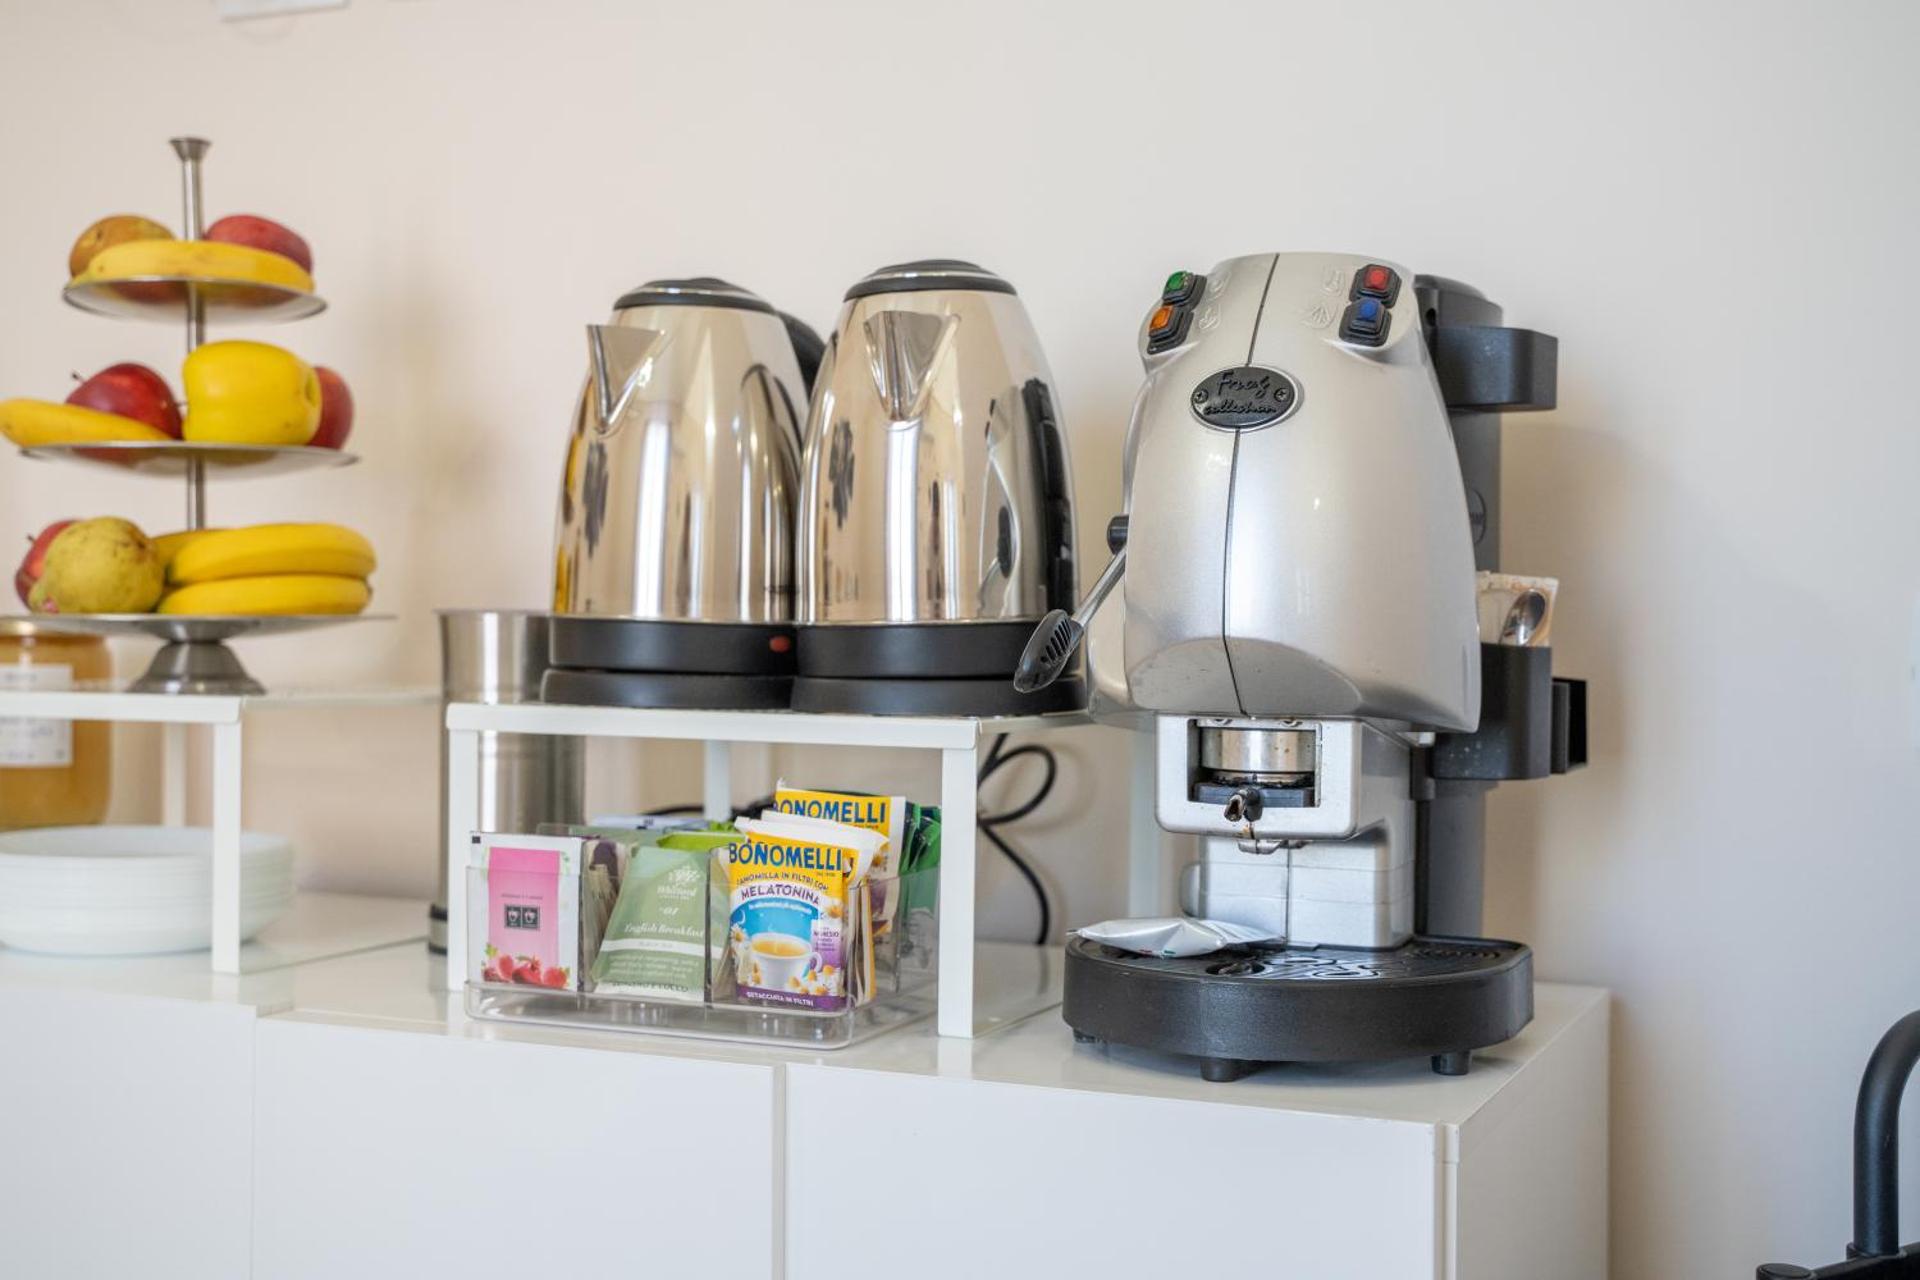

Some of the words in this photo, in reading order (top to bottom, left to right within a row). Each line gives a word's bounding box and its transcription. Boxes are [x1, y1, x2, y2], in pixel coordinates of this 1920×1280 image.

[728, 842, 842, 871] BONOMELLI
[781, 871, 790, 879] IN
[741, 884, 819, 905] MELATONINA
